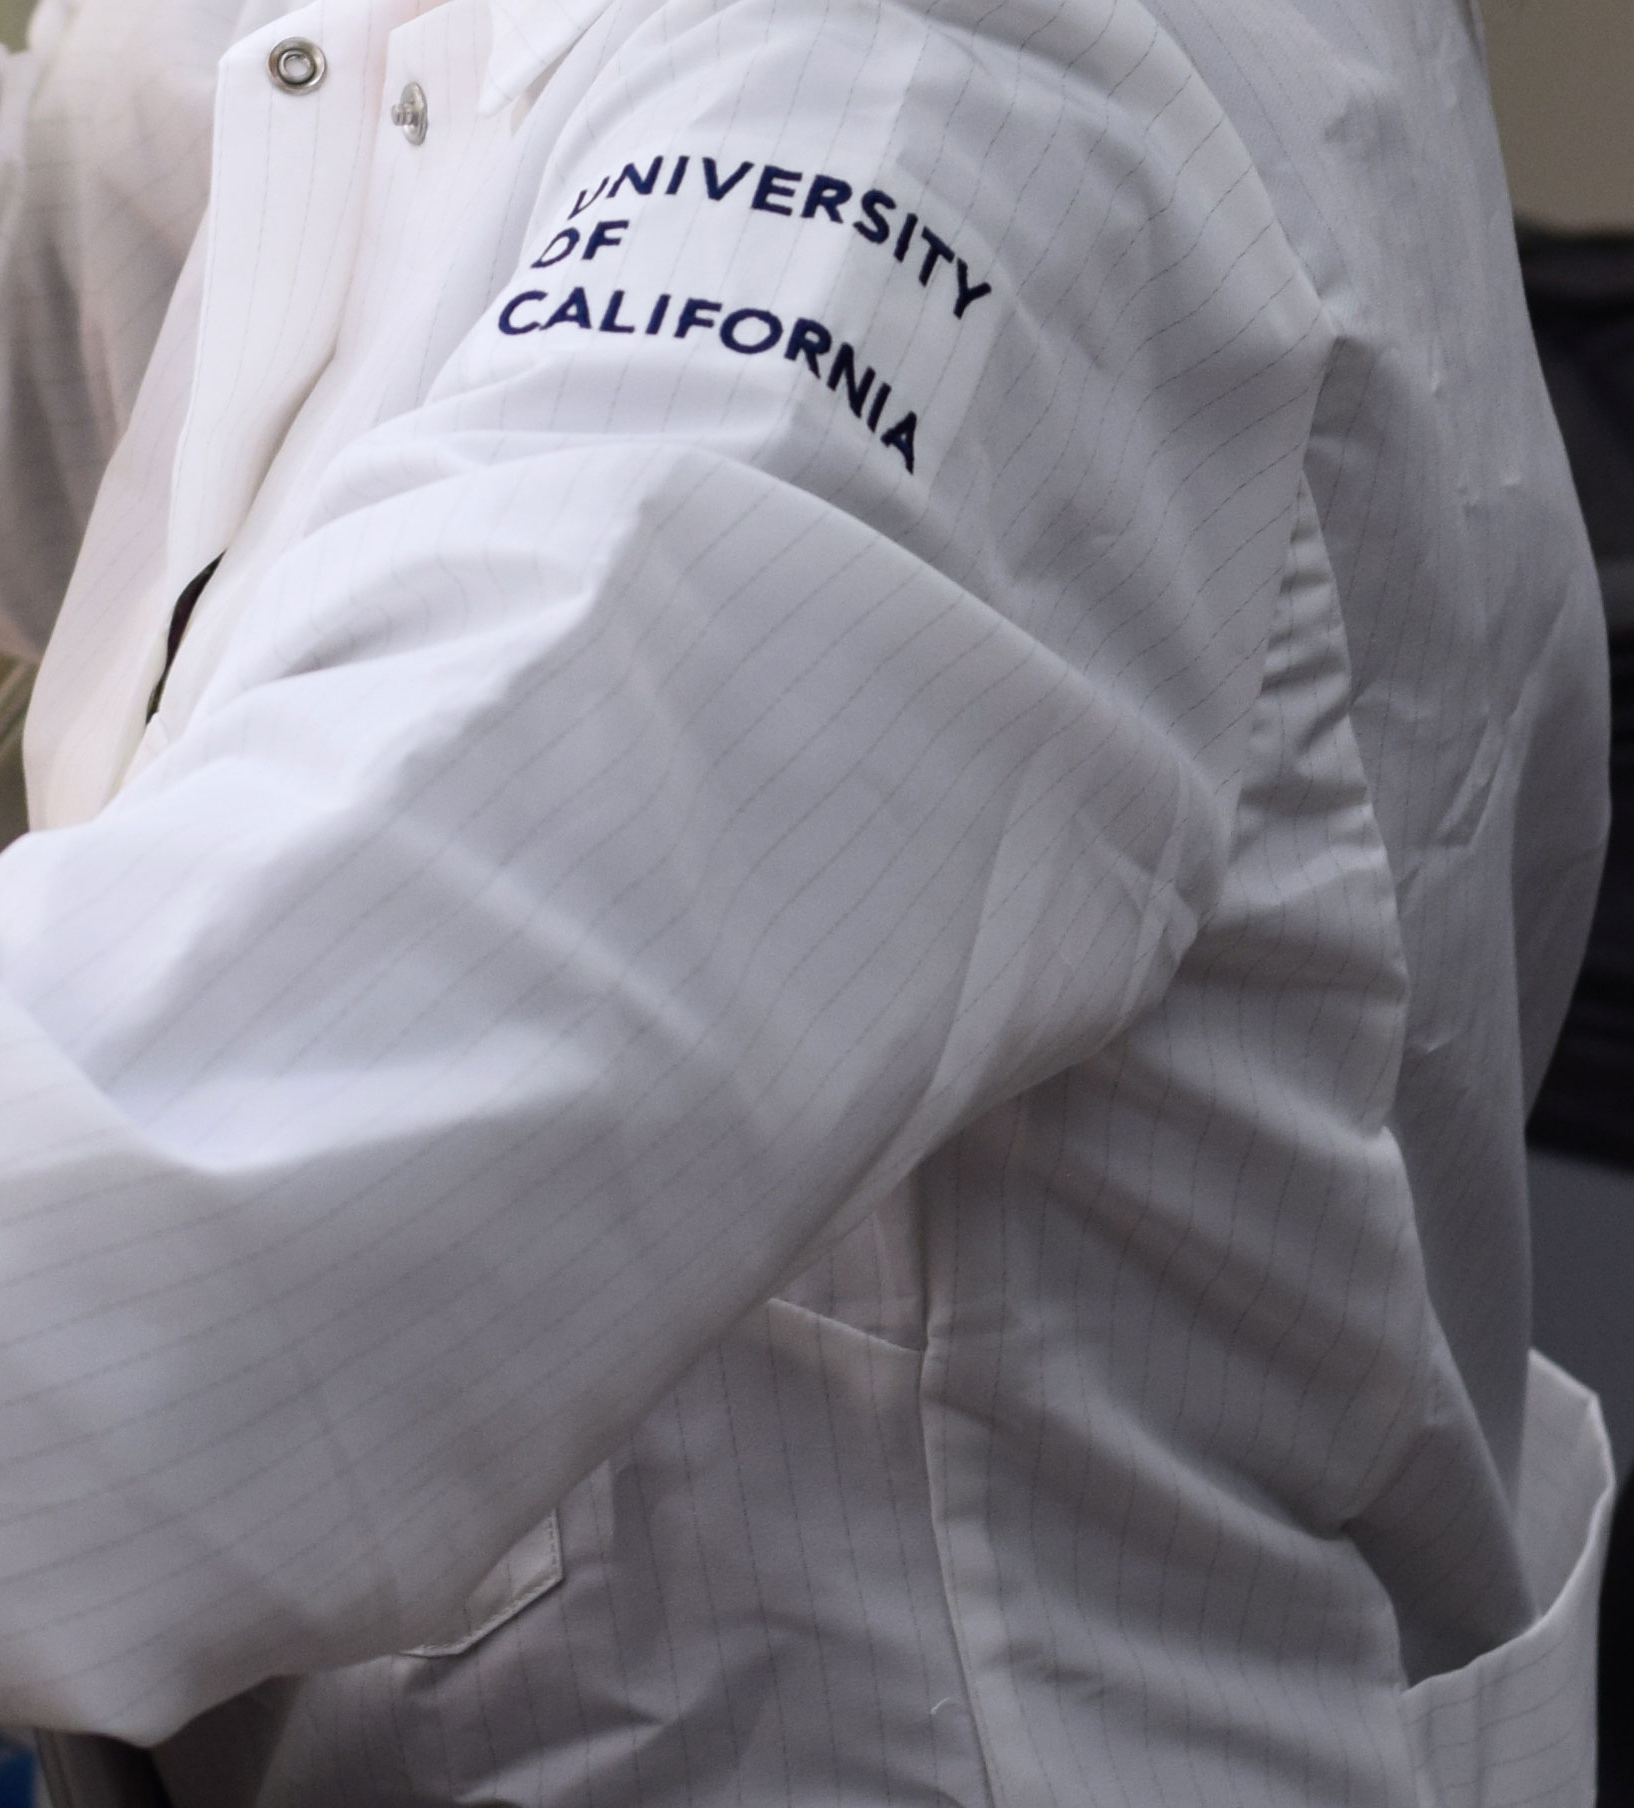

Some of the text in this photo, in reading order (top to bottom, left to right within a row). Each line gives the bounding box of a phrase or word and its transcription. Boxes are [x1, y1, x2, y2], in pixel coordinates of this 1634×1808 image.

[530, 220, 630, 269] OF
[567, 155, 992, 319] UNIVERSITY
[497, 287, 918, 475] CALIFORNIA
